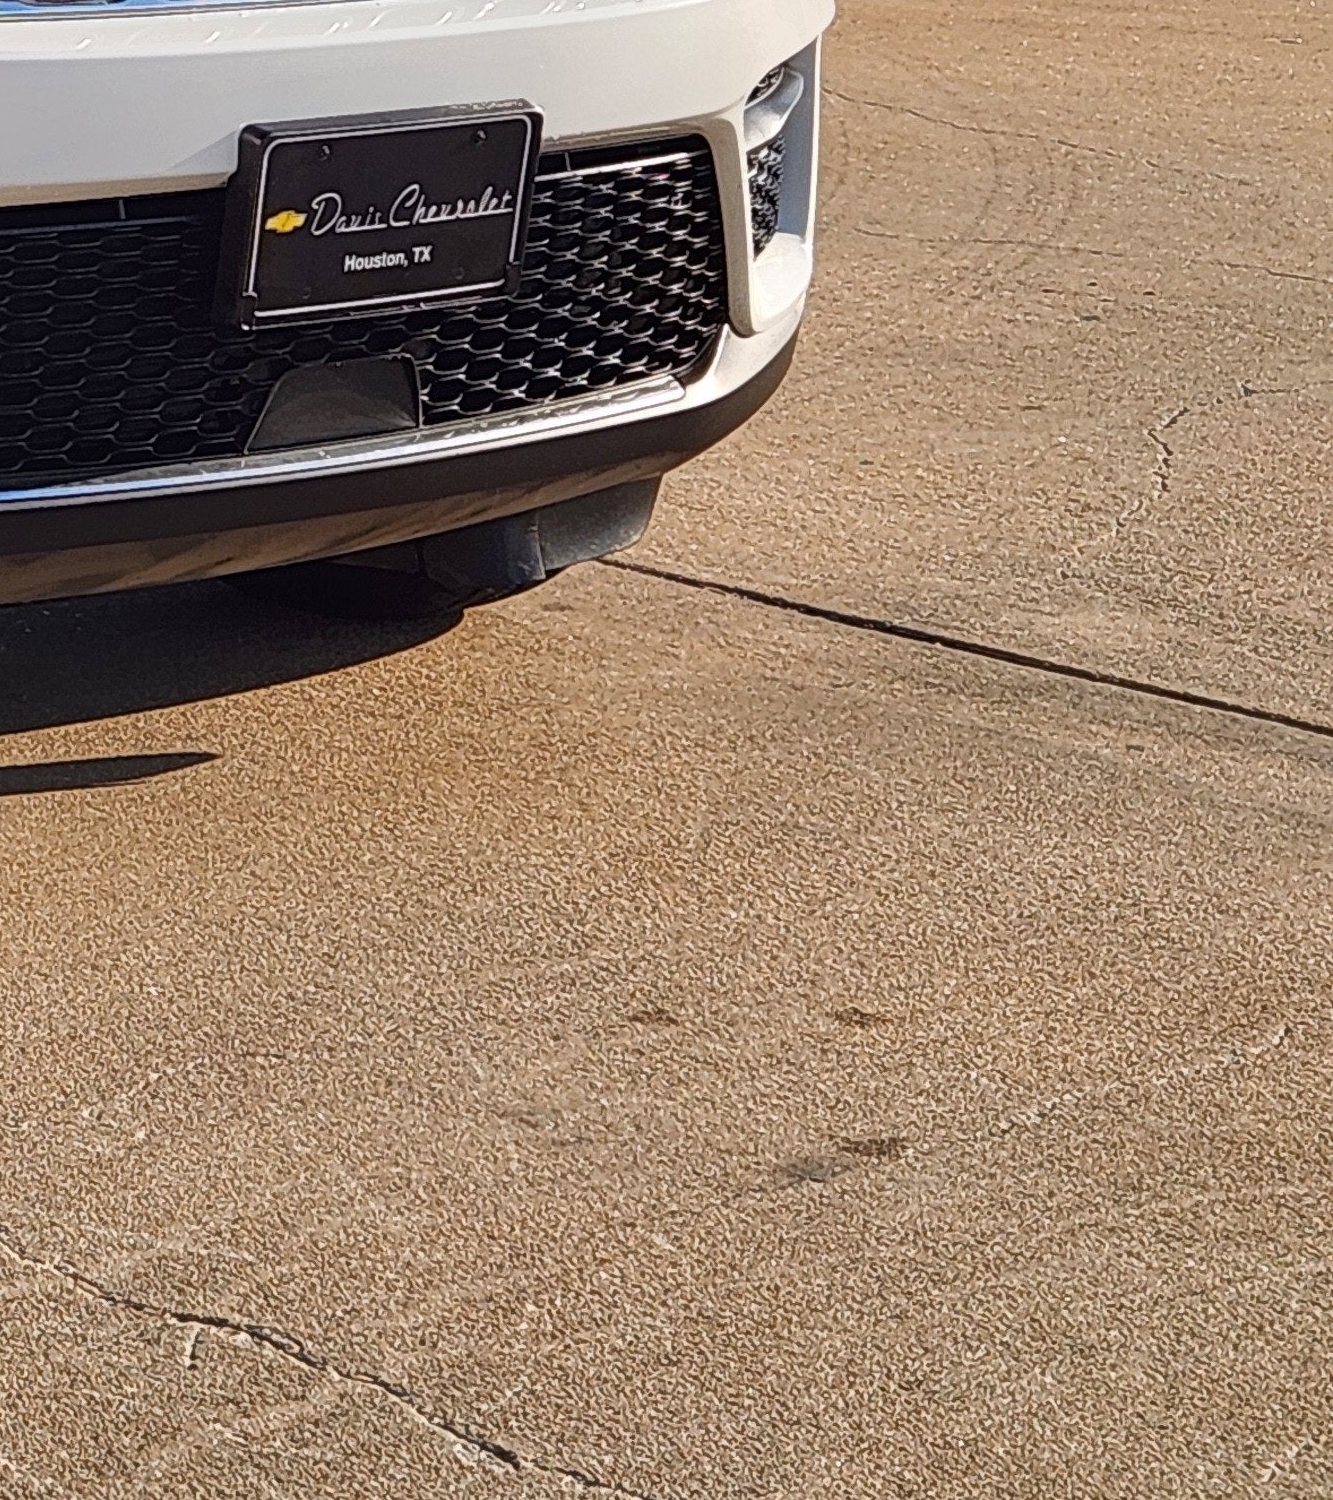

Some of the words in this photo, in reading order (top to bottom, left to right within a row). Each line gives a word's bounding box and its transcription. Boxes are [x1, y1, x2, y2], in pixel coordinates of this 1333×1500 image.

[309, 191, 388, 237] Davis
[388, 183, 514, 228] Chevrolet
[343, 252, 409, 273] Houston,
[412, 245, 434, 264] TX
